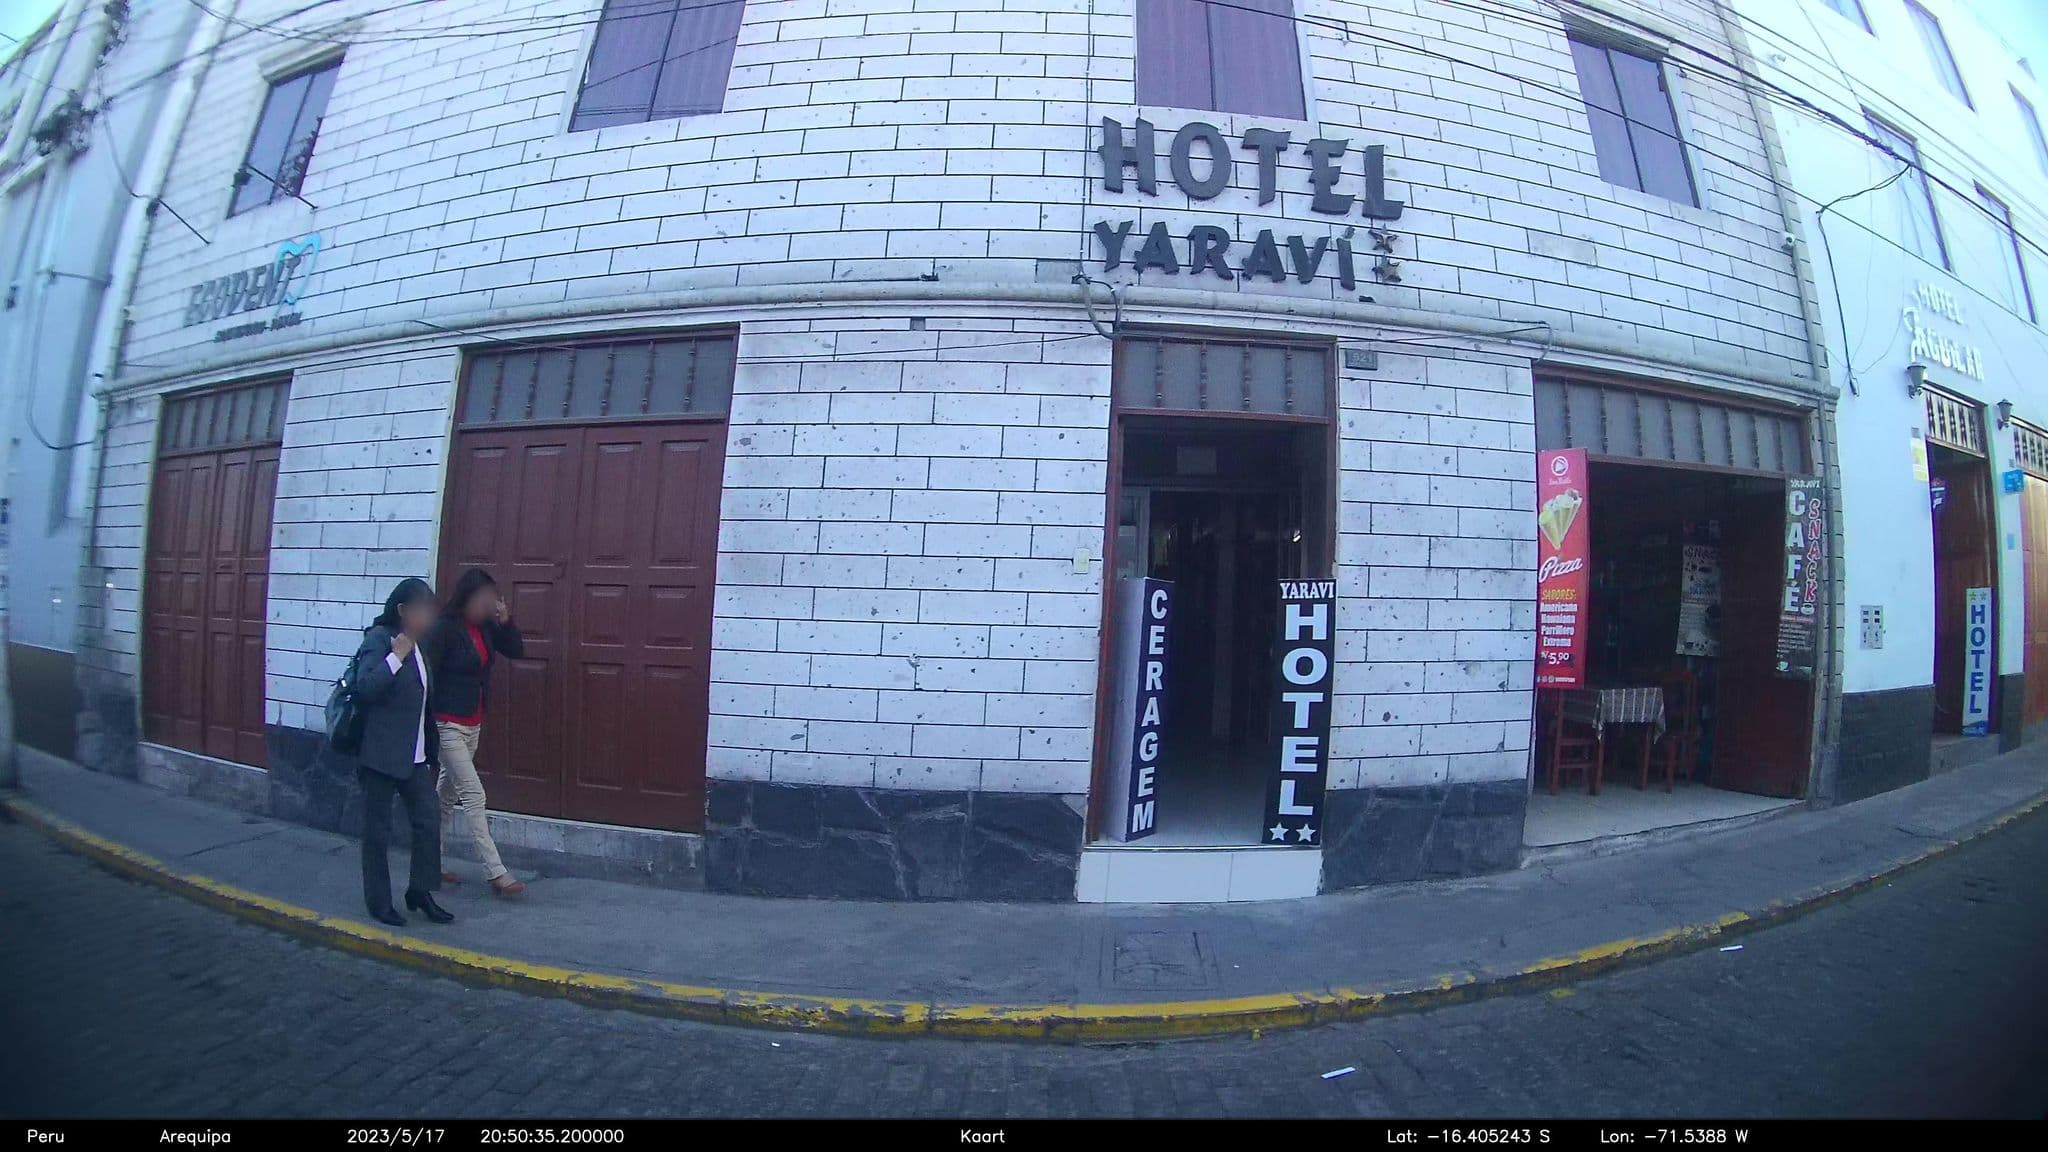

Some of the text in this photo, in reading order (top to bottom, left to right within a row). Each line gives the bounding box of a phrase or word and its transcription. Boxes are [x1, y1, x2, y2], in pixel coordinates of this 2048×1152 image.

[1098, 116, 1404, 220] HOTEL
[1094, 220, 1355, 291] YARAVÍ
[1280, 582, 1335, 599] YARAVI
[1539, 556, 1582, 583] Pizza
[1785, 491, 1806, 612] CAFÉ
[1805, 498, 1821, 603] SNACK
[1132, 589, 1168, 834] CERAGEM
[1278, 603, 1328, 816] HOTEL
[1970, 604, 1986, 714] HOTEL
